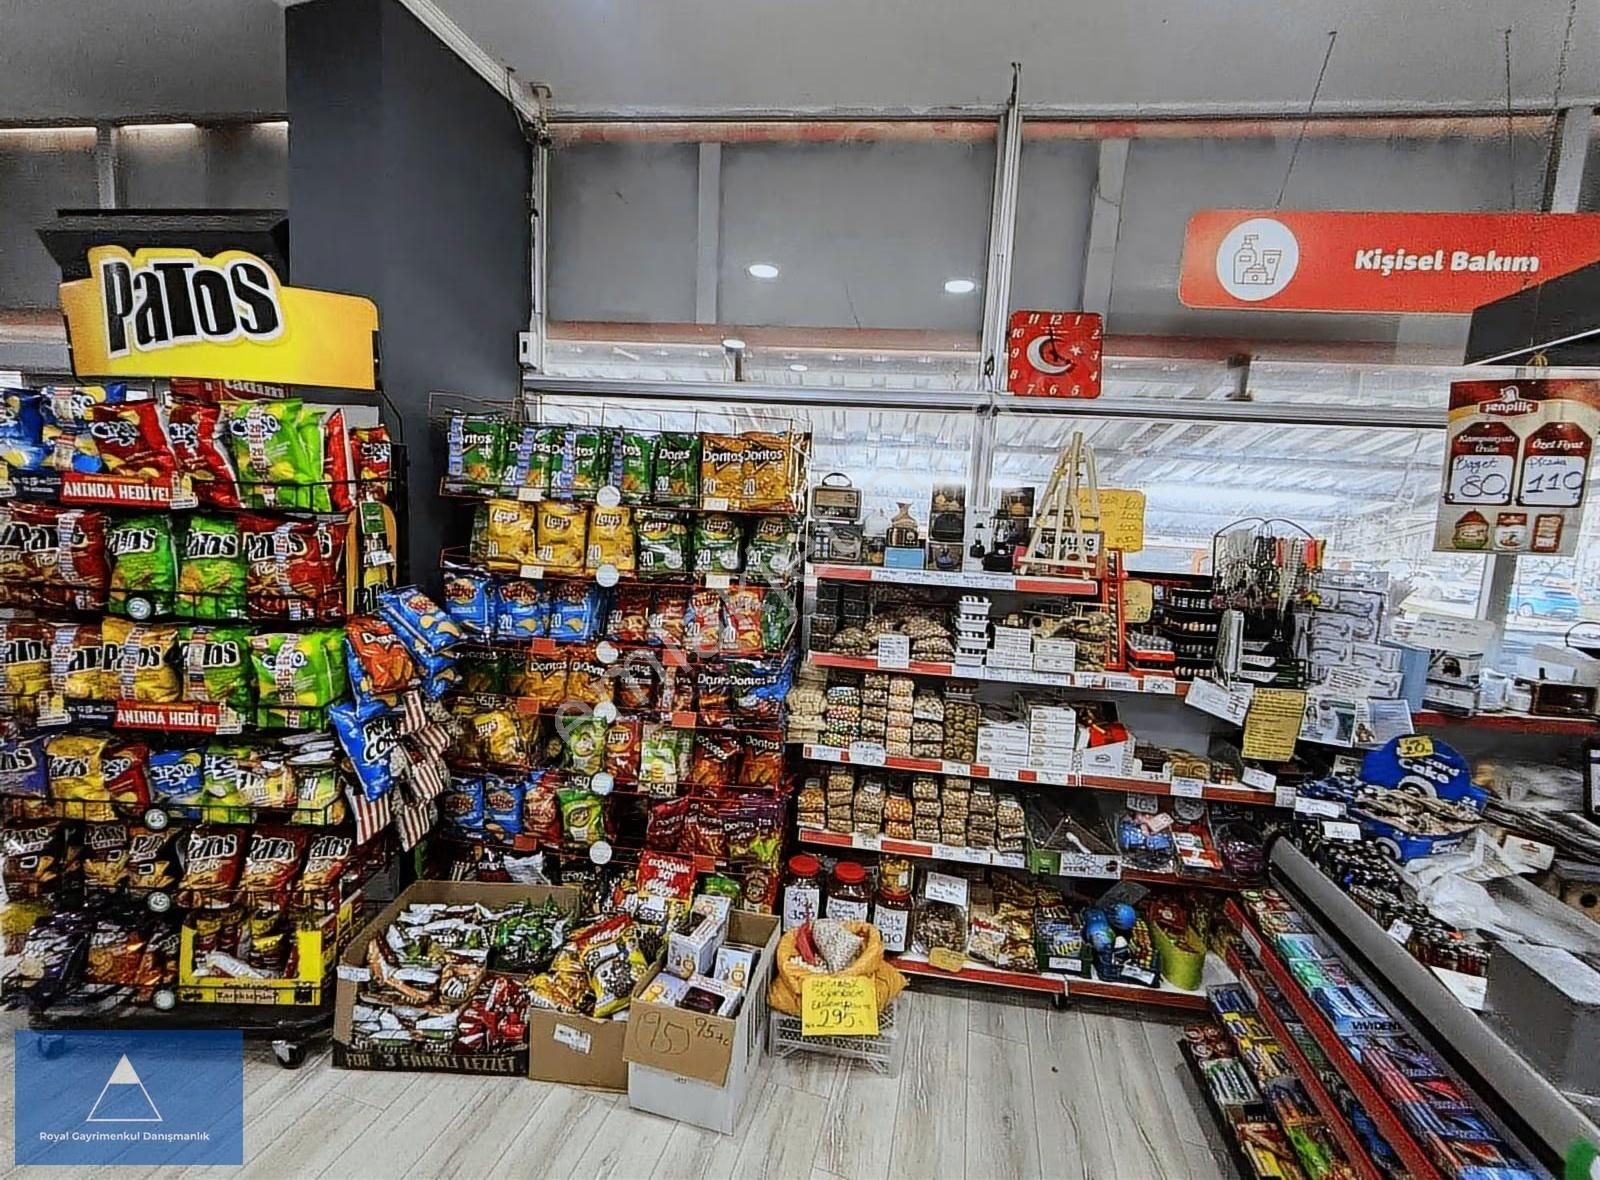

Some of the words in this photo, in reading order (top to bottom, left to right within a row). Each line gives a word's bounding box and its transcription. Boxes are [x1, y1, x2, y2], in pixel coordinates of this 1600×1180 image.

[1355, 249, 1444, 277] Kişisel
[1451, 250, 1540, 272] Bakım
[1028, 314, 1041, 324] 11
[1050, 315, 1063, 325] 12
[1075, 315, 1081, 325] 1
[1012, 328, 1024, 338] 10
[1091, 329, 1100, 339] 2
[1011, 348, 1019, 358] 9
[1091, 351, 1099, 360] 3
[1010, 370, 1018, 379] 8
[1090, 371, 1098, 381] 4
[1028, 384, 1035, 394] 7
[1050, 385, 1057, 395] 6
[1072, 385, 1080, 395] 5
[1532, 439, 1555, 449] Özel
[1557, 440, 1584, 450] Fiyat
[1461, 474, 1507, 497] 80
[1526, 471, 1583, 493] 110
[63, 482, 113, 498] ANINDA
[119, 482, 169, 502] HEDİYE!
[117, 709, 165, 725] ANINDA
[169, 709, 217, 728] HEDİYE!
[1398, 758, 1450, 784] Cake
[640, 1010, 690, 1055] 95
[695, 1017, 718, 1038] 95
[384, 1055, 396, 1067] 3
[463, 1056, 517, 1072] LEZZET
